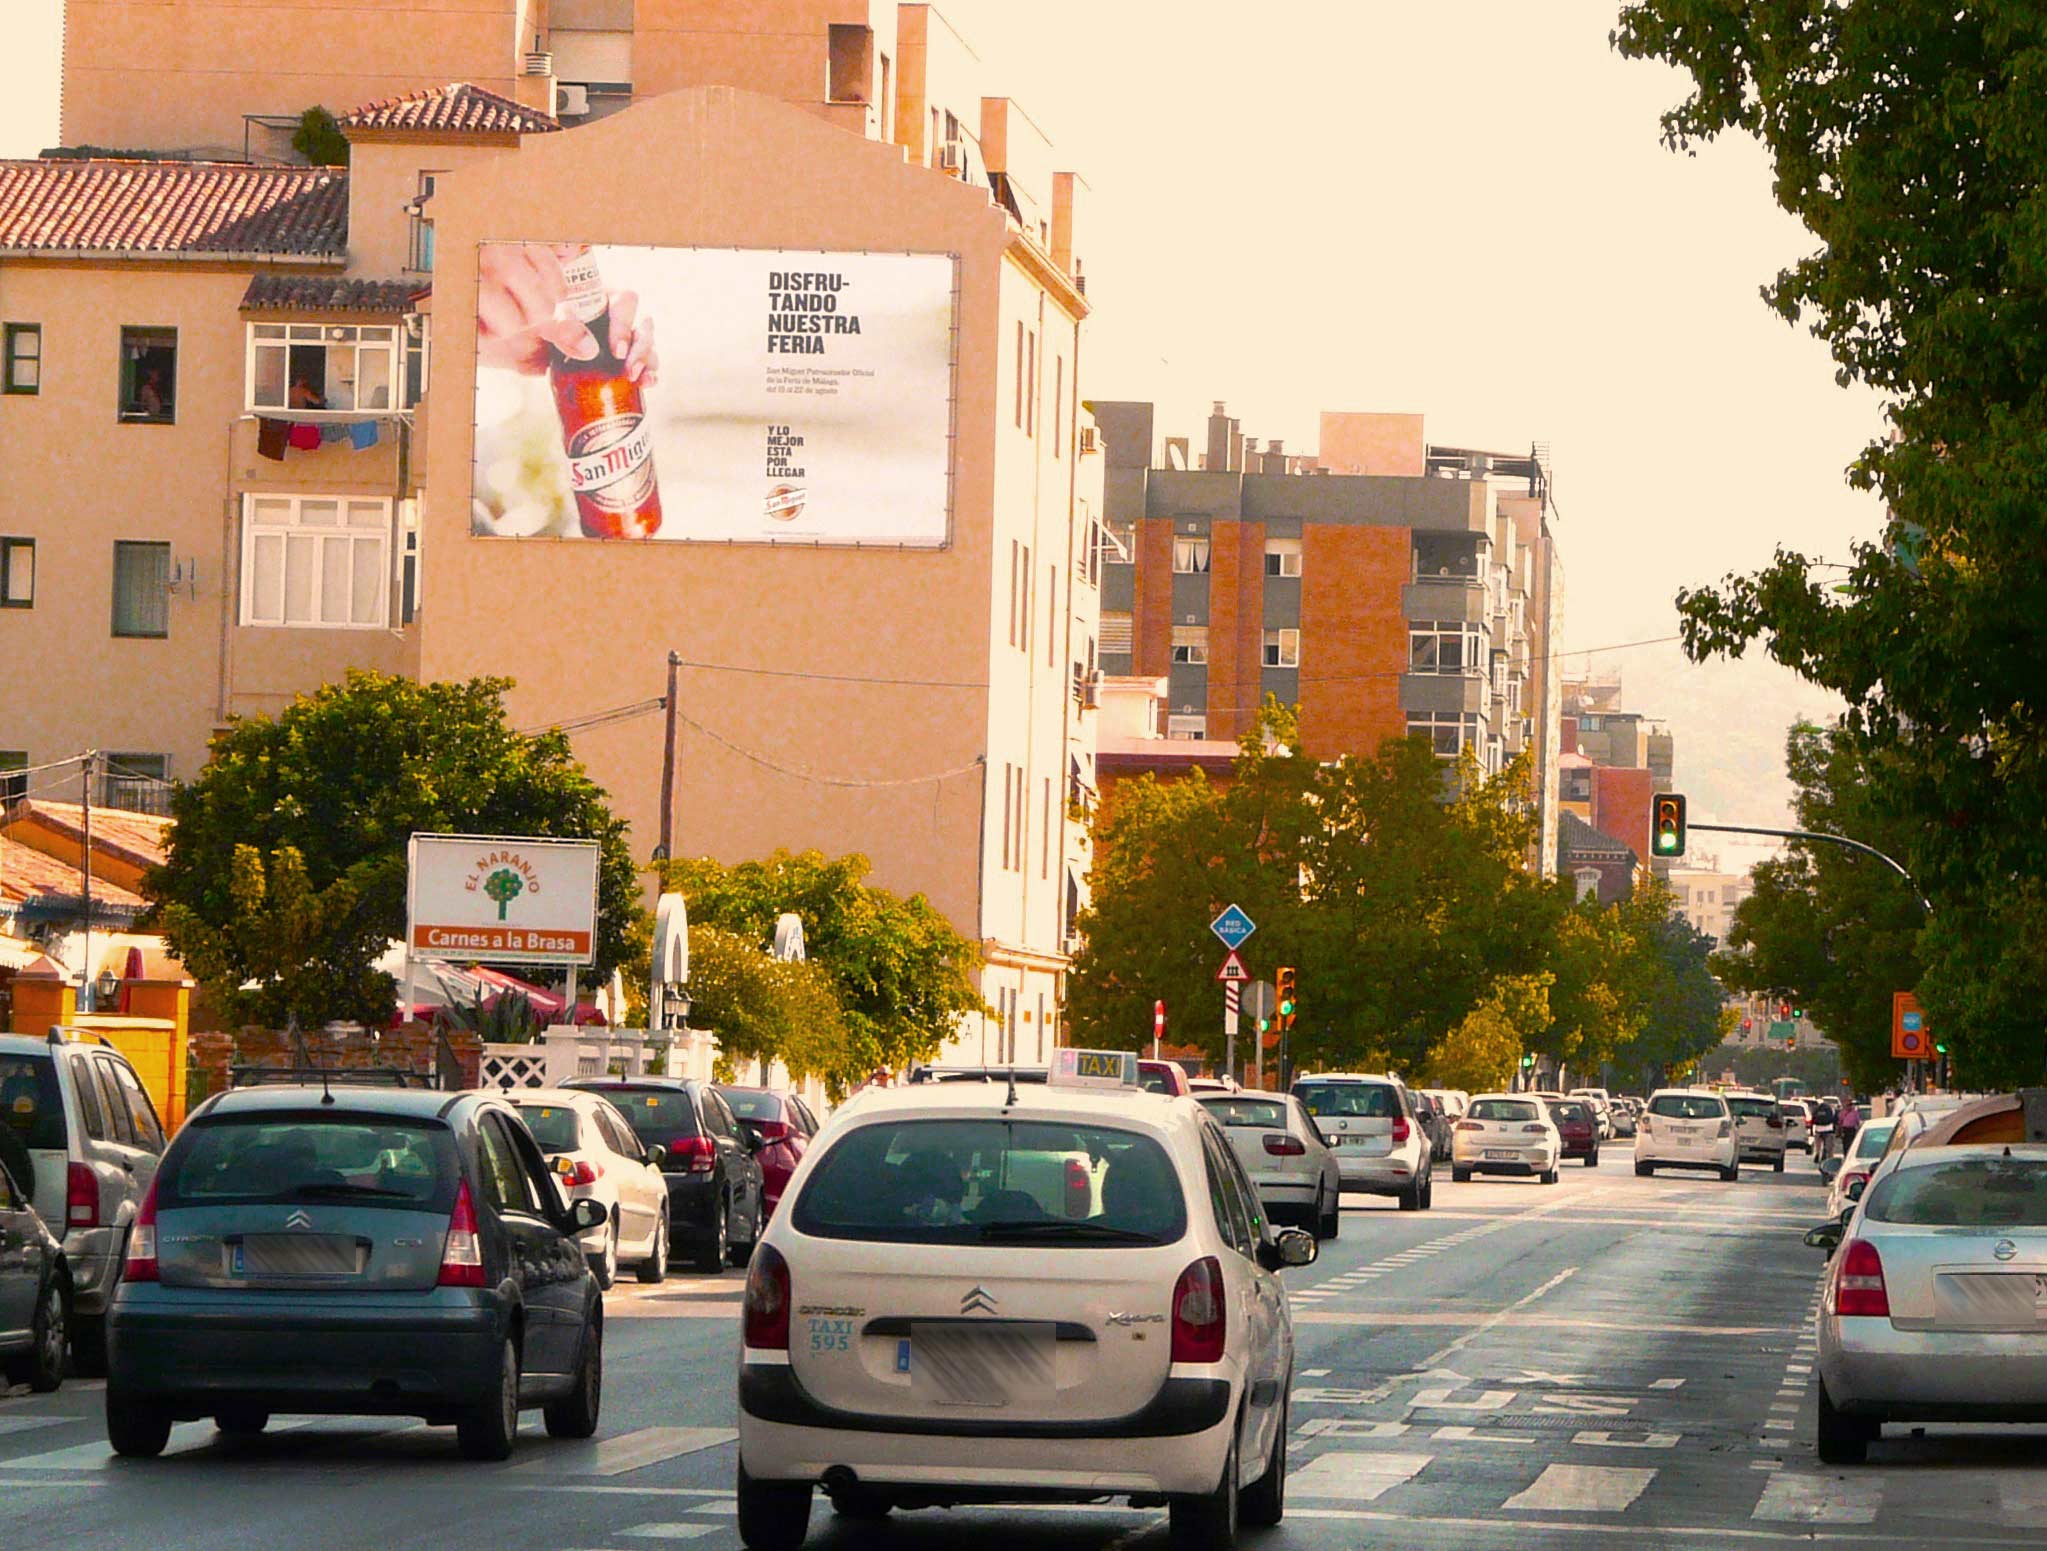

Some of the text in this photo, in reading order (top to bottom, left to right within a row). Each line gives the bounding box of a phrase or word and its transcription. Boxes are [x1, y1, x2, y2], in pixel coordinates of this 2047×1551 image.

[769, 272, 850, 292] DISFRU-
[768, 293, 837, 313] TANDO
[768, 314, 861, 334] NUESTRA
[767, 335, 825, 354] FERIA
[768, 426, 790, 436] Y LO
[767, 436, 804, 447] MEJOR
[767, 447, 793, 457] ESTA
[767, 457, 788, 467] POR
[571, 462, 606, 487] San
[766, 468, 805, 477] LLEGAR
[465, 851, 540, 894] EL NARANJO
[427, 928, 576, 951] Carnes a la Brasa
[1079, 1054, 1121, 1077] TAXI
[807, 1317, 854, 1335] TAXI
[809, 1334, 849, 1352] 595
